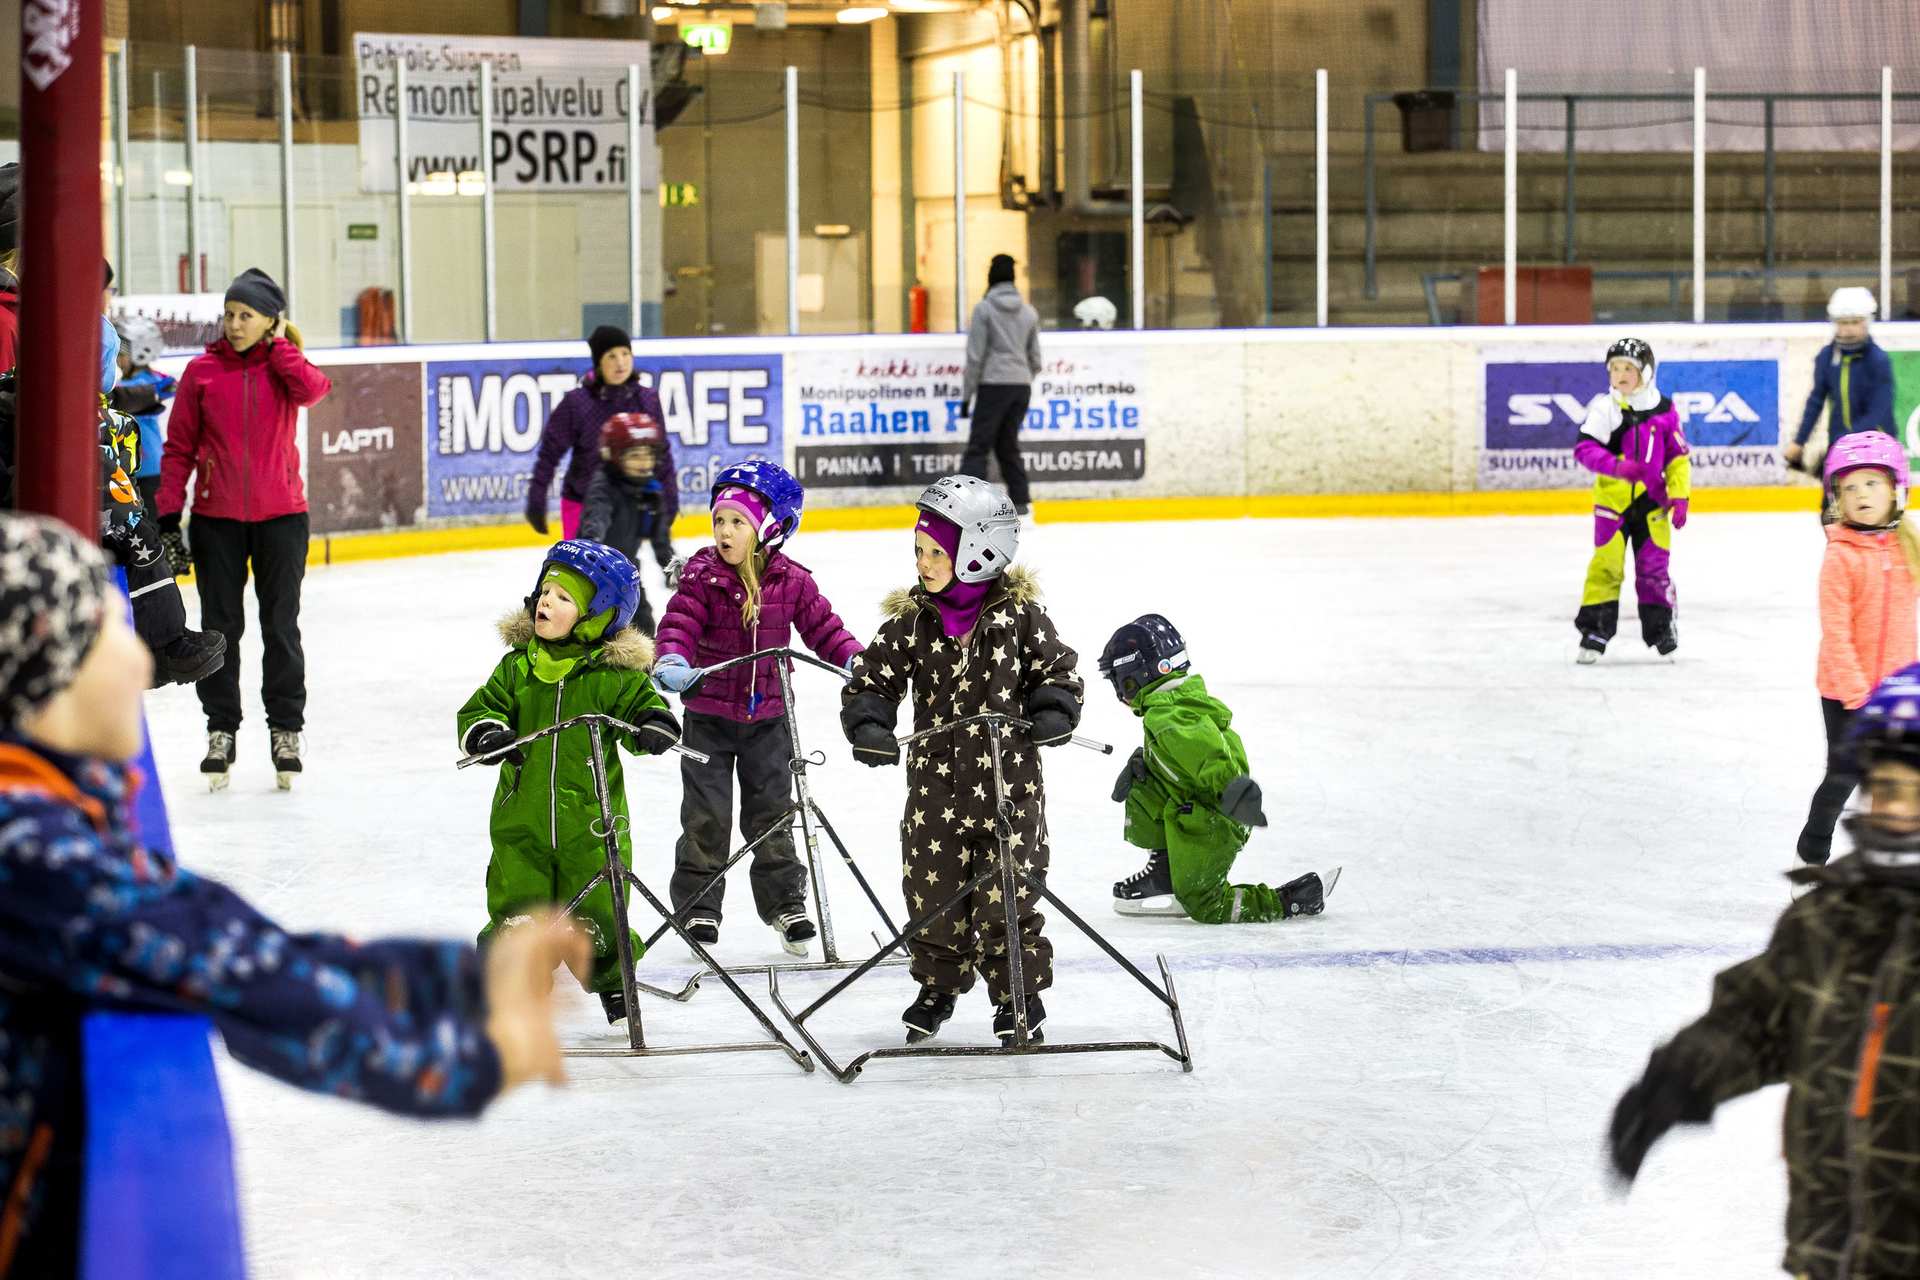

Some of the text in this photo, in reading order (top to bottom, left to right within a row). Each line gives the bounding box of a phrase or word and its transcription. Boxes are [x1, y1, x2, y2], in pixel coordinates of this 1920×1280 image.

[362, 75, 604, 124] Remontipalvelu
[453, 370, 769, 454] MOTAFE
[801, 399, 1139, 435] Raahen PoPiste
[1019, 450, 1123, 472] TULOSTAA
